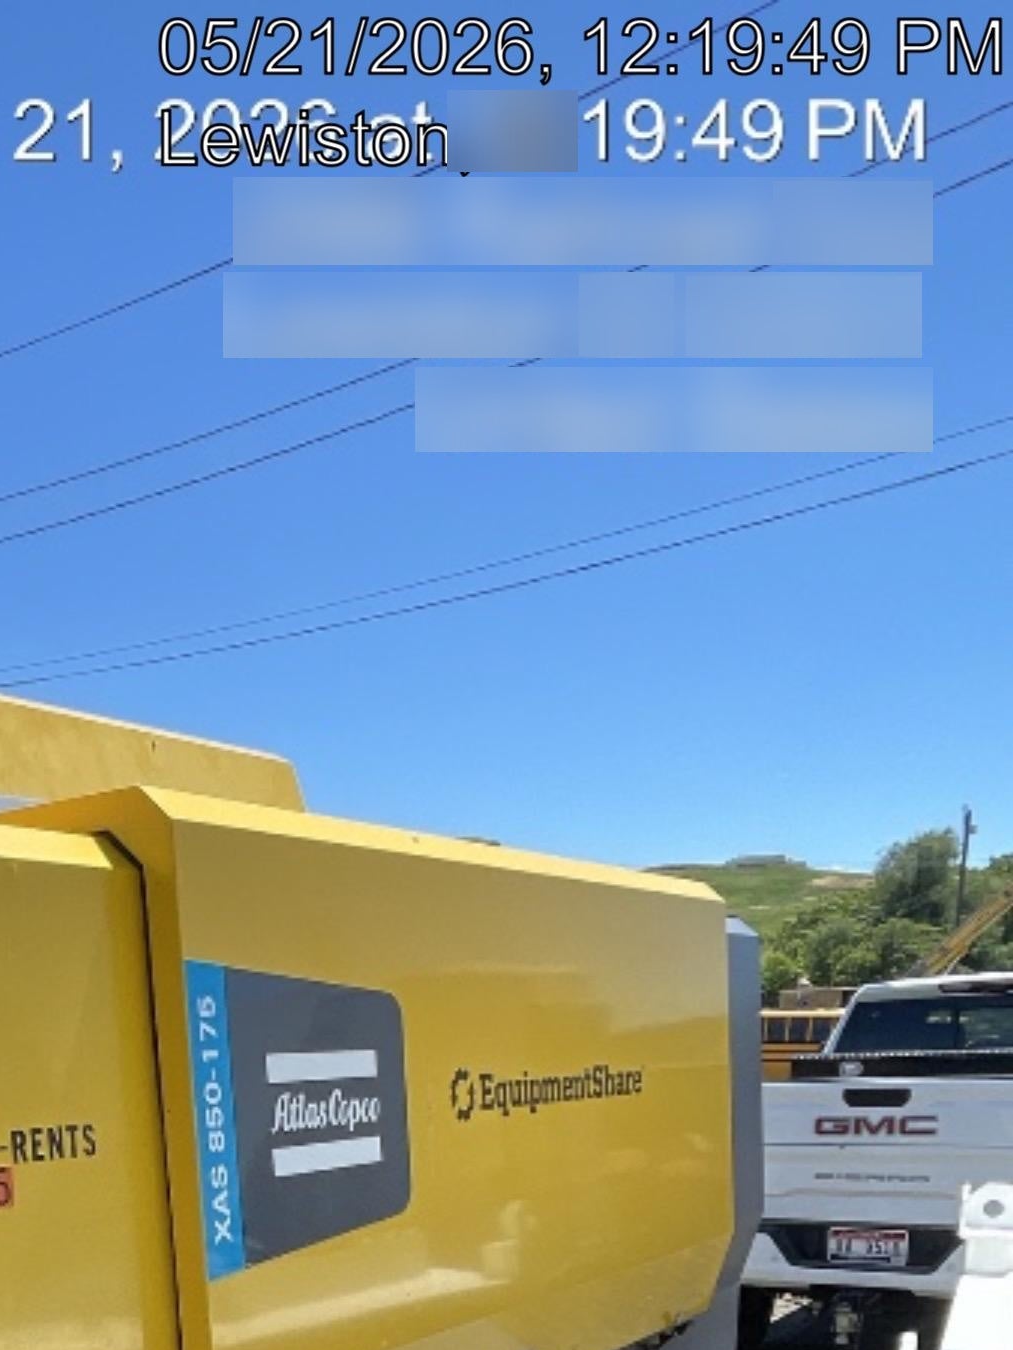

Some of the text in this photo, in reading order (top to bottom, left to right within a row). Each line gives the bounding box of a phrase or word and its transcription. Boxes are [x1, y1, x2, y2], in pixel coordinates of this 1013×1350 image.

[479, 1064, 643, 1117] EquipmentShare
[815, 1115, 938, 1136] GMC
[211, 1163, 234, 1246] XAS
